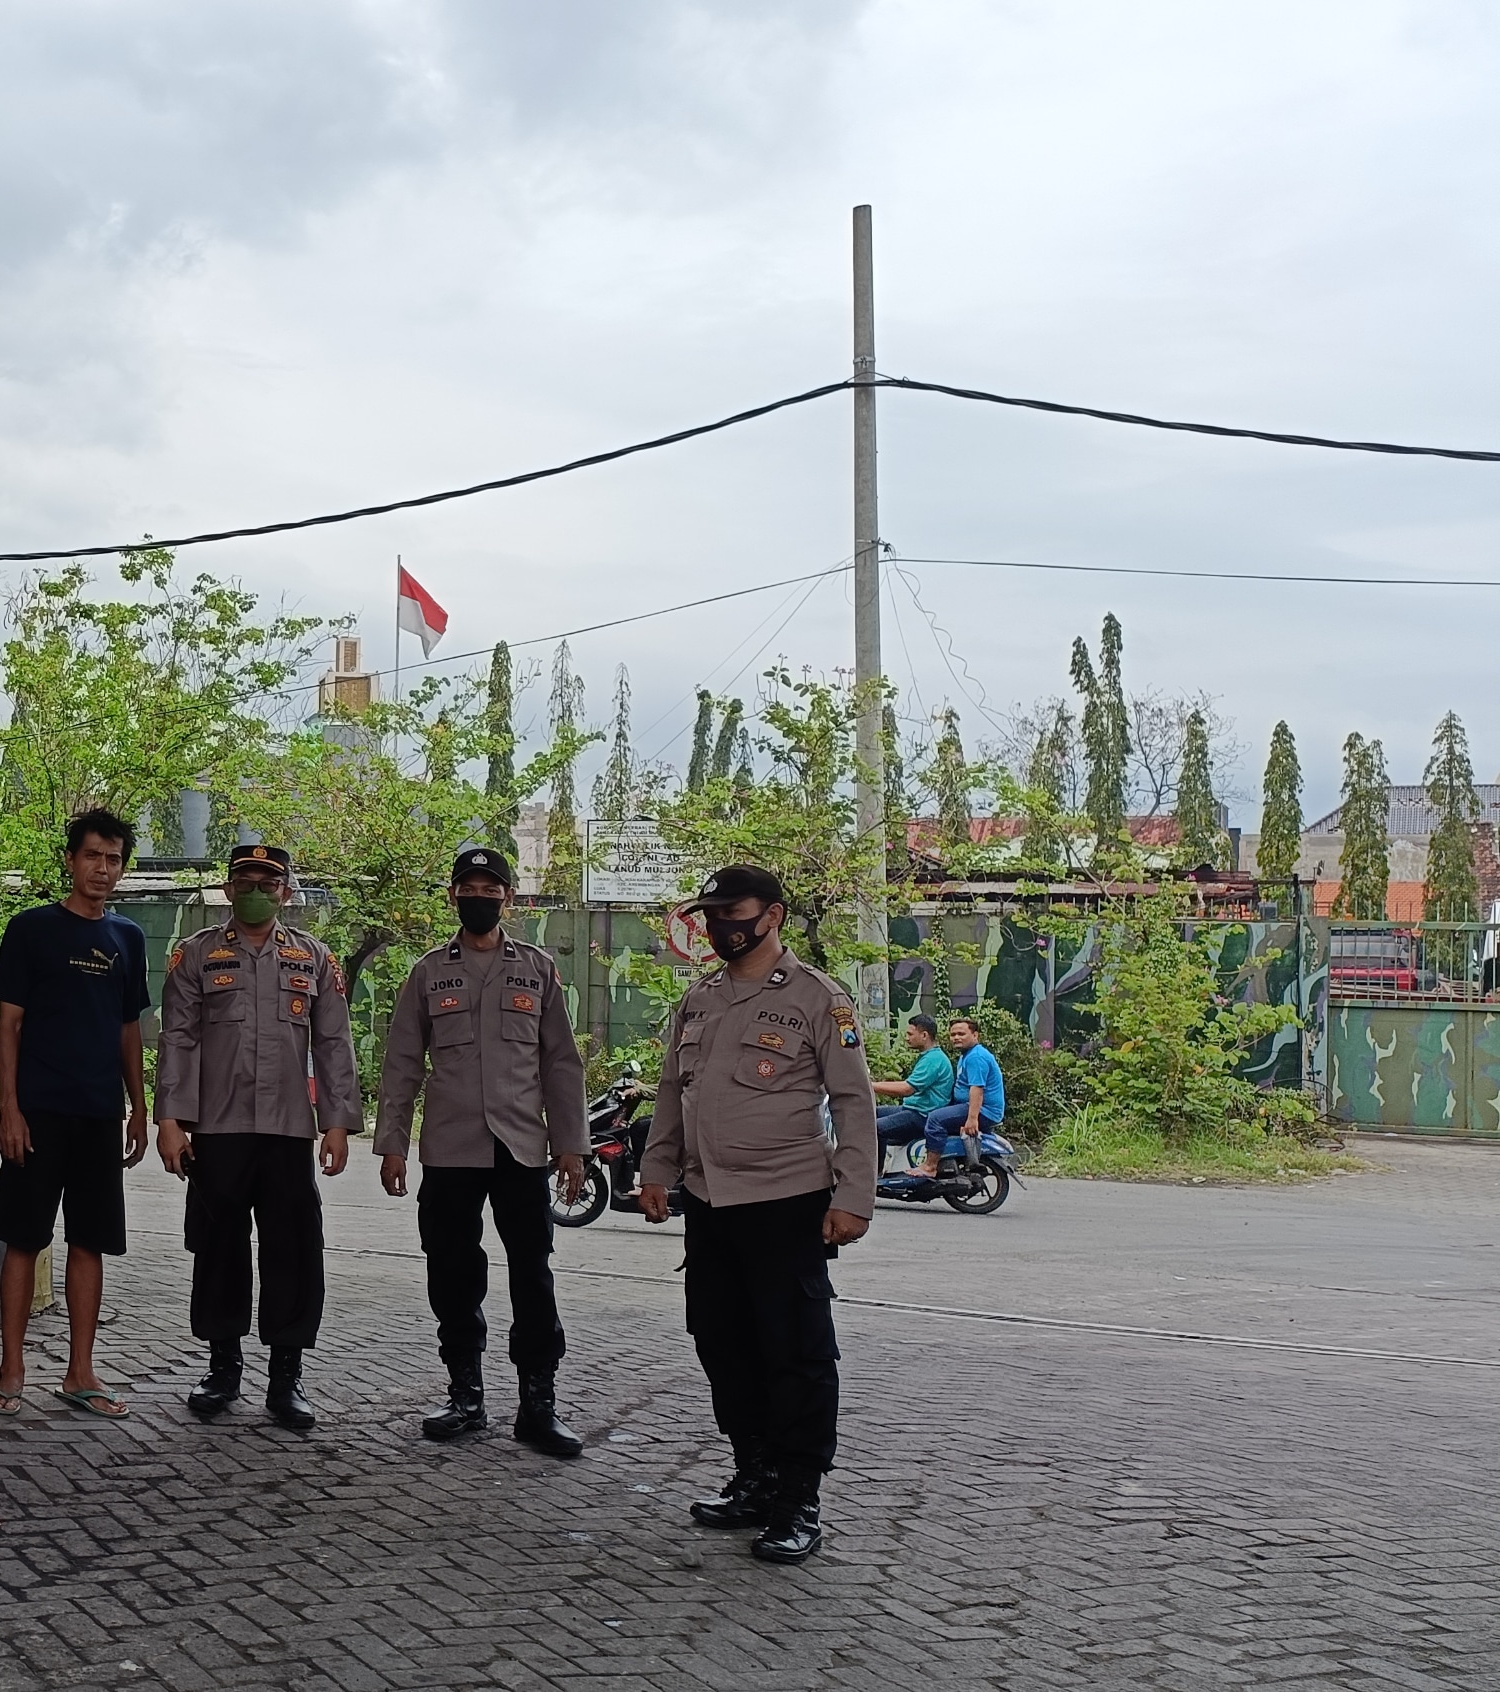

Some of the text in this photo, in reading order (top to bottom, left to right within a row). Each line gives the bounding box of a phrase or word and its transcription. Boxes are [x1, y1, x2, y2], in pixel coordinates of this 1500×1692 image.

[280, 961, 314, 974] POLRI
[430, 978, 463, 991] JOKO
[506, 976, 540, 990] POLRI
[757, 1011, 803, 1030] POLRI
